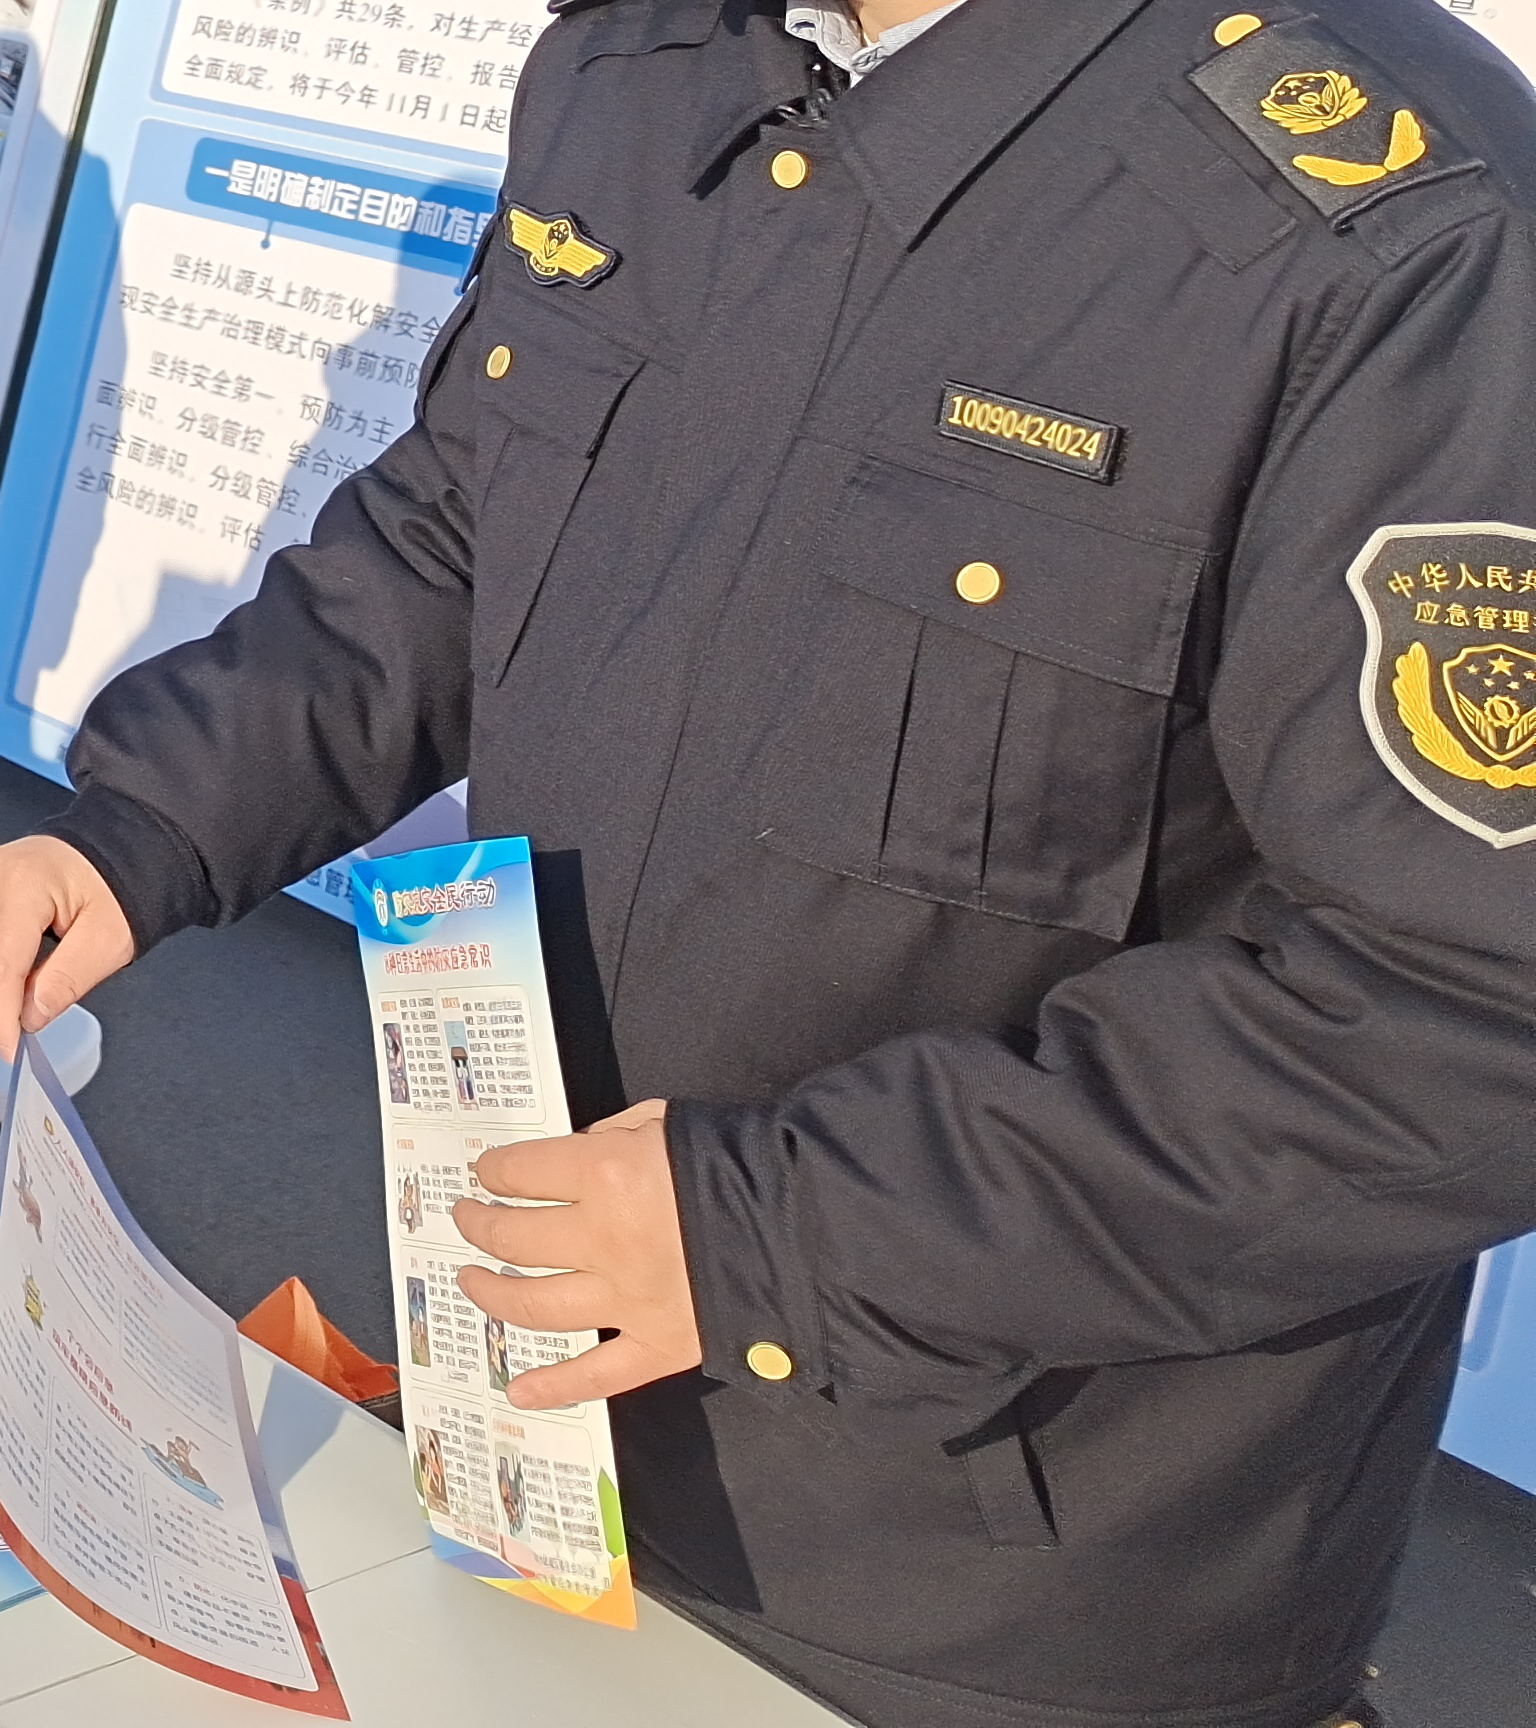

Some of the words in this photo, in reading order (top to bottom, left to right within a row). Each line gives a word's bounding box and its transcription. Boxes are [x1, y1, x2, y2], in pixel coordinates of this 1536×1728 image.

[171, 252, 440, 345] 坚持从源头上防范化解安全
[948, 395, 1103, 461] 10090424024
[1387, 561, 1536, 599] 中华人民共
[1415, 600, 1536, 634] 应急管理
